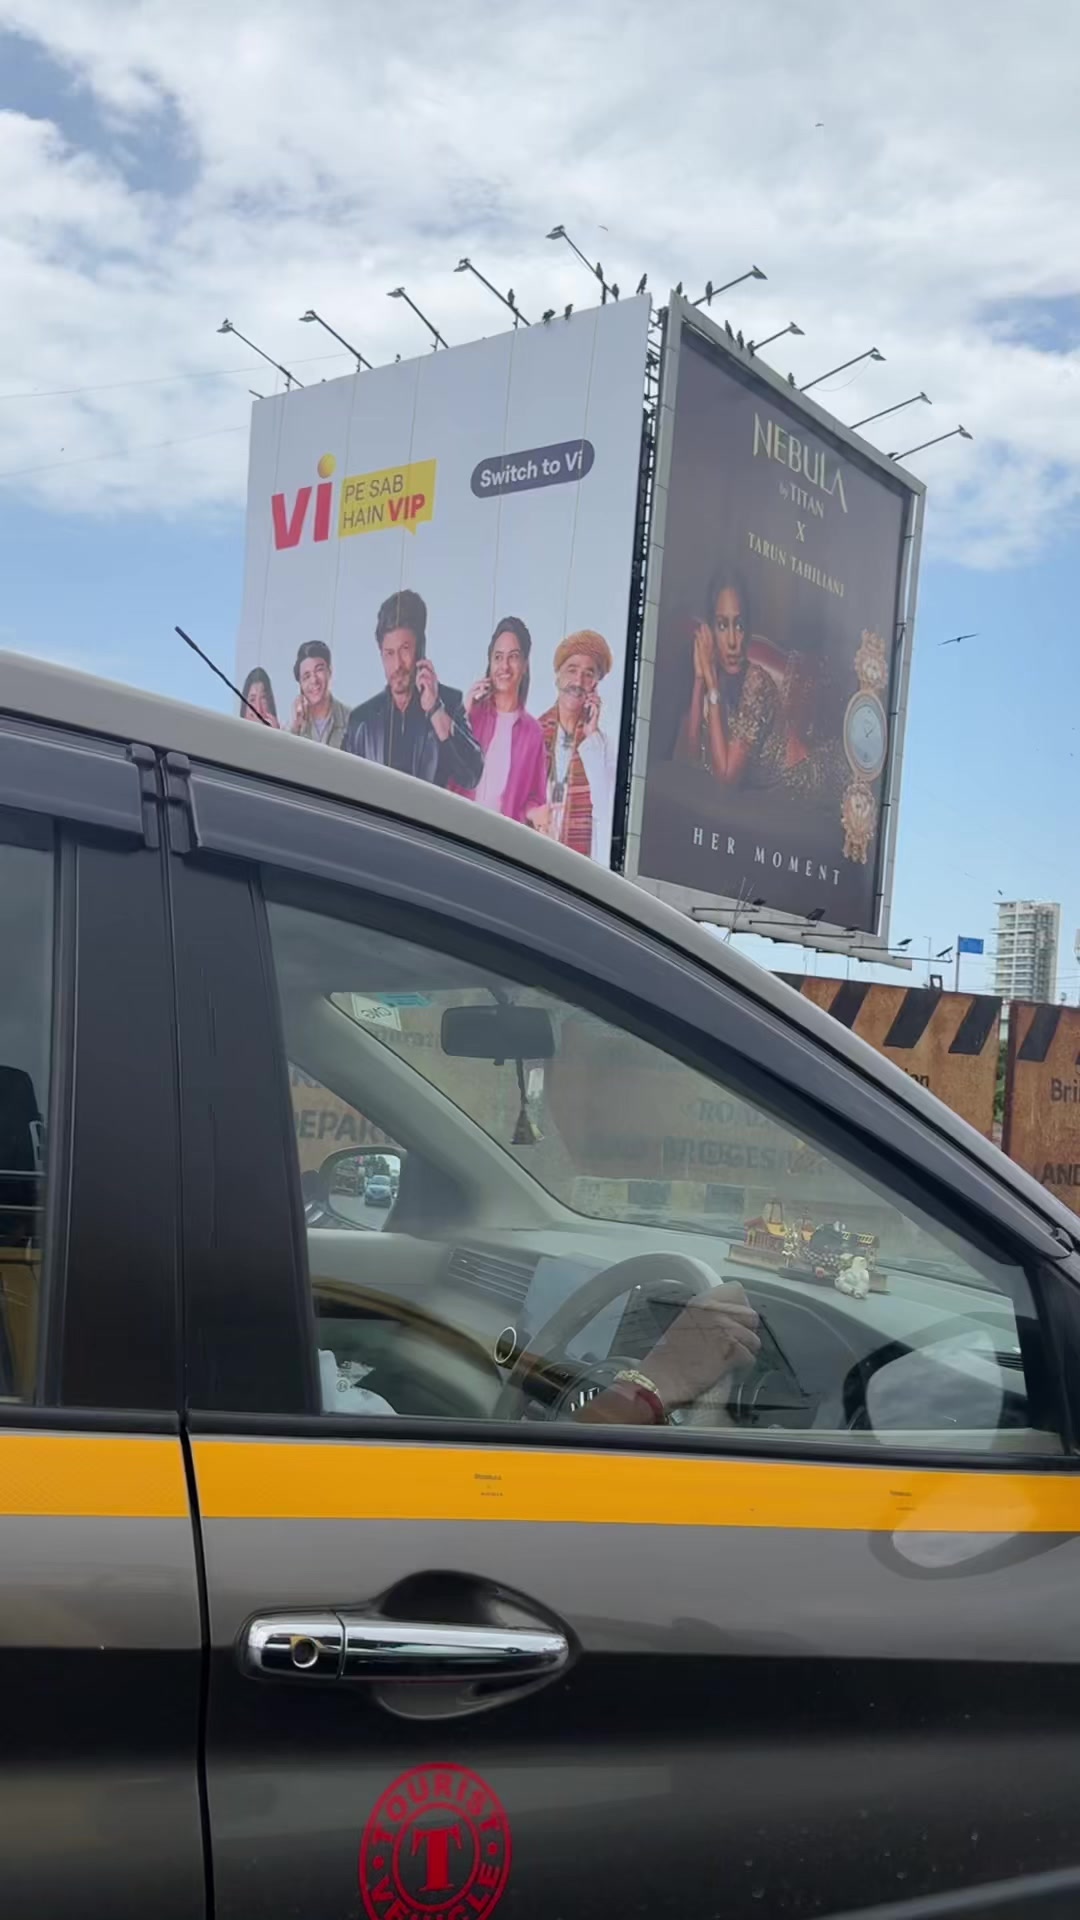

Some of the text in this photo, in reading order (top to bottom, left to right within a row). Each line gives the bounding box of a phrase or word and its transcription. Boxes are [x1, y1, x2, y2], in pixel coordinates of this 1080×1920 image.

[345, 474, 404, 503] PE SAB
[480, 450, 583, 488] Switch to Vi
[343, 493, 425, 529] HAIN VIP
[790, 483, 824, 518] TITAN
[748, 532, 844, 597] TARUN TAHILIANI
[693, 827, 840, 885] HER MOMENT
[371, 1773, 500, 1845] TOURIST
[410, 1823, 463, 1892] T
